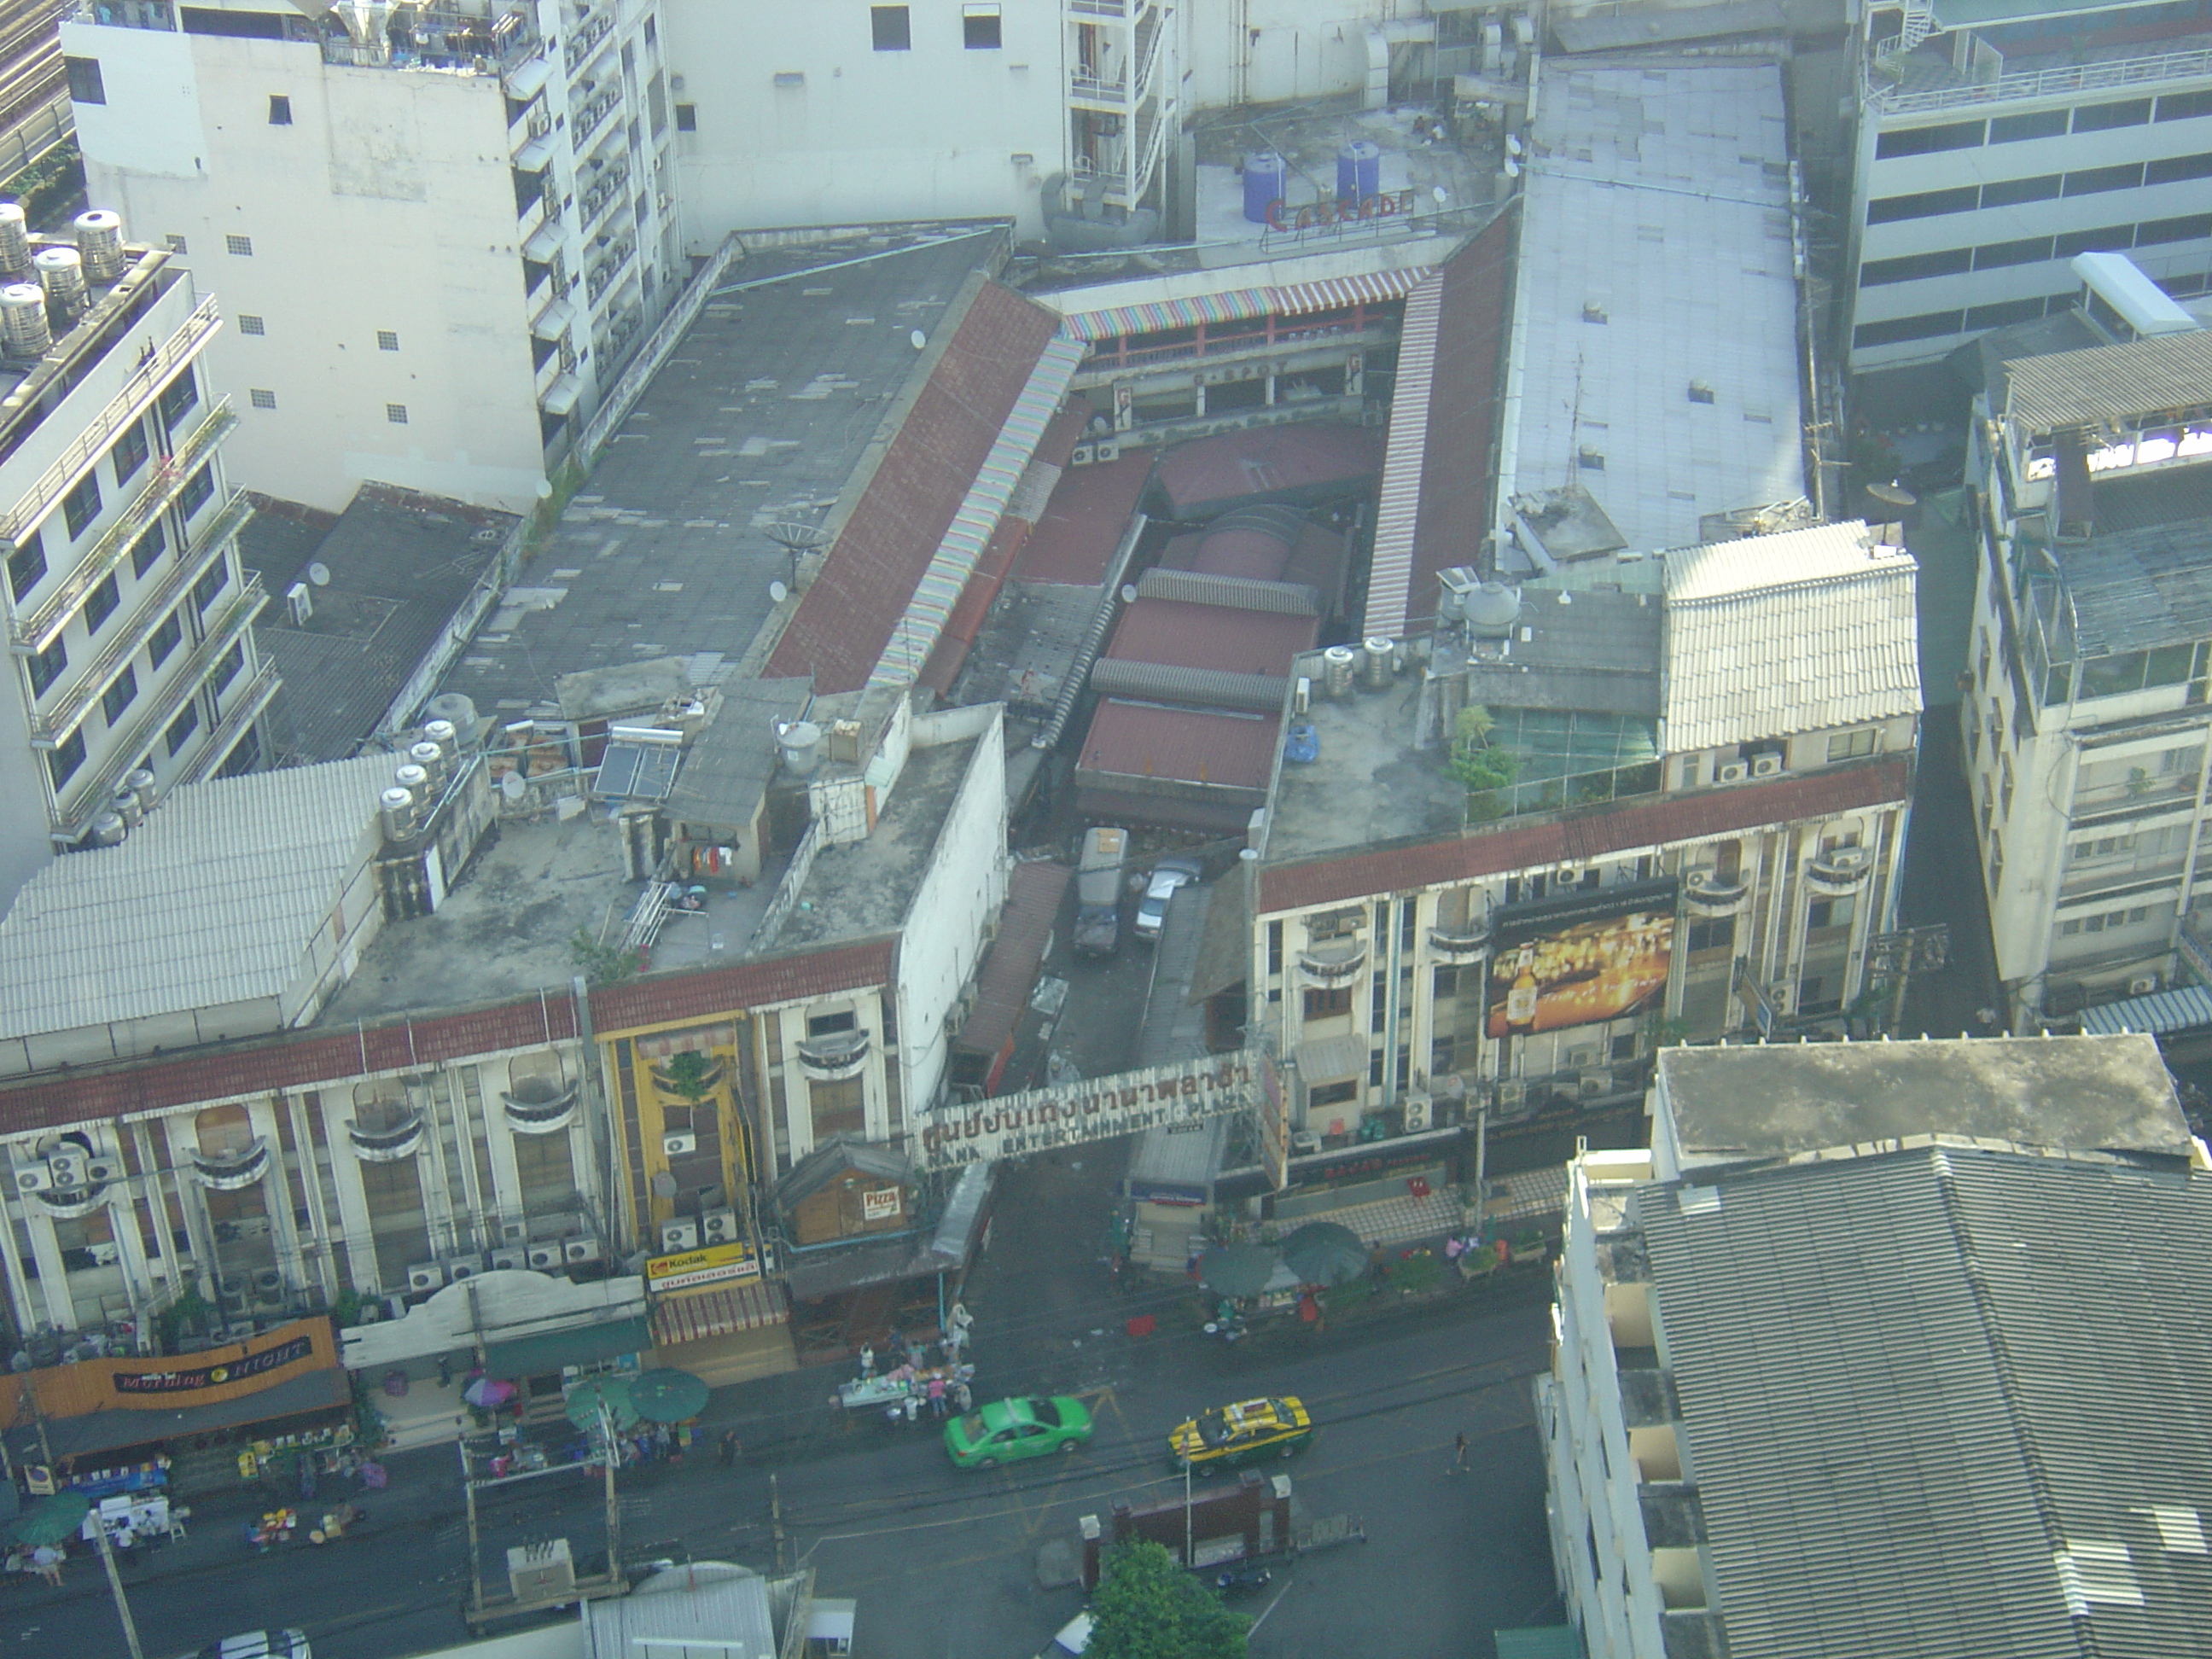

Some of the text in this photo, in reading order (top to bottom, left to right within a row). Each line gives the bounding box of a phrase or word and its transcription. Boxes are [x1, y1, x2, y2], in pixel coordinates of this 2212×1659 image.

[1266, 190, 1414, 232] CASCADE
[928, 1145, 981, 1167] NANA
[866, 1191, 896, 1206] Pizza
[669, 1254, 707, 1268] Kodak
[234, 1341, 306, 1376] NIGHT
